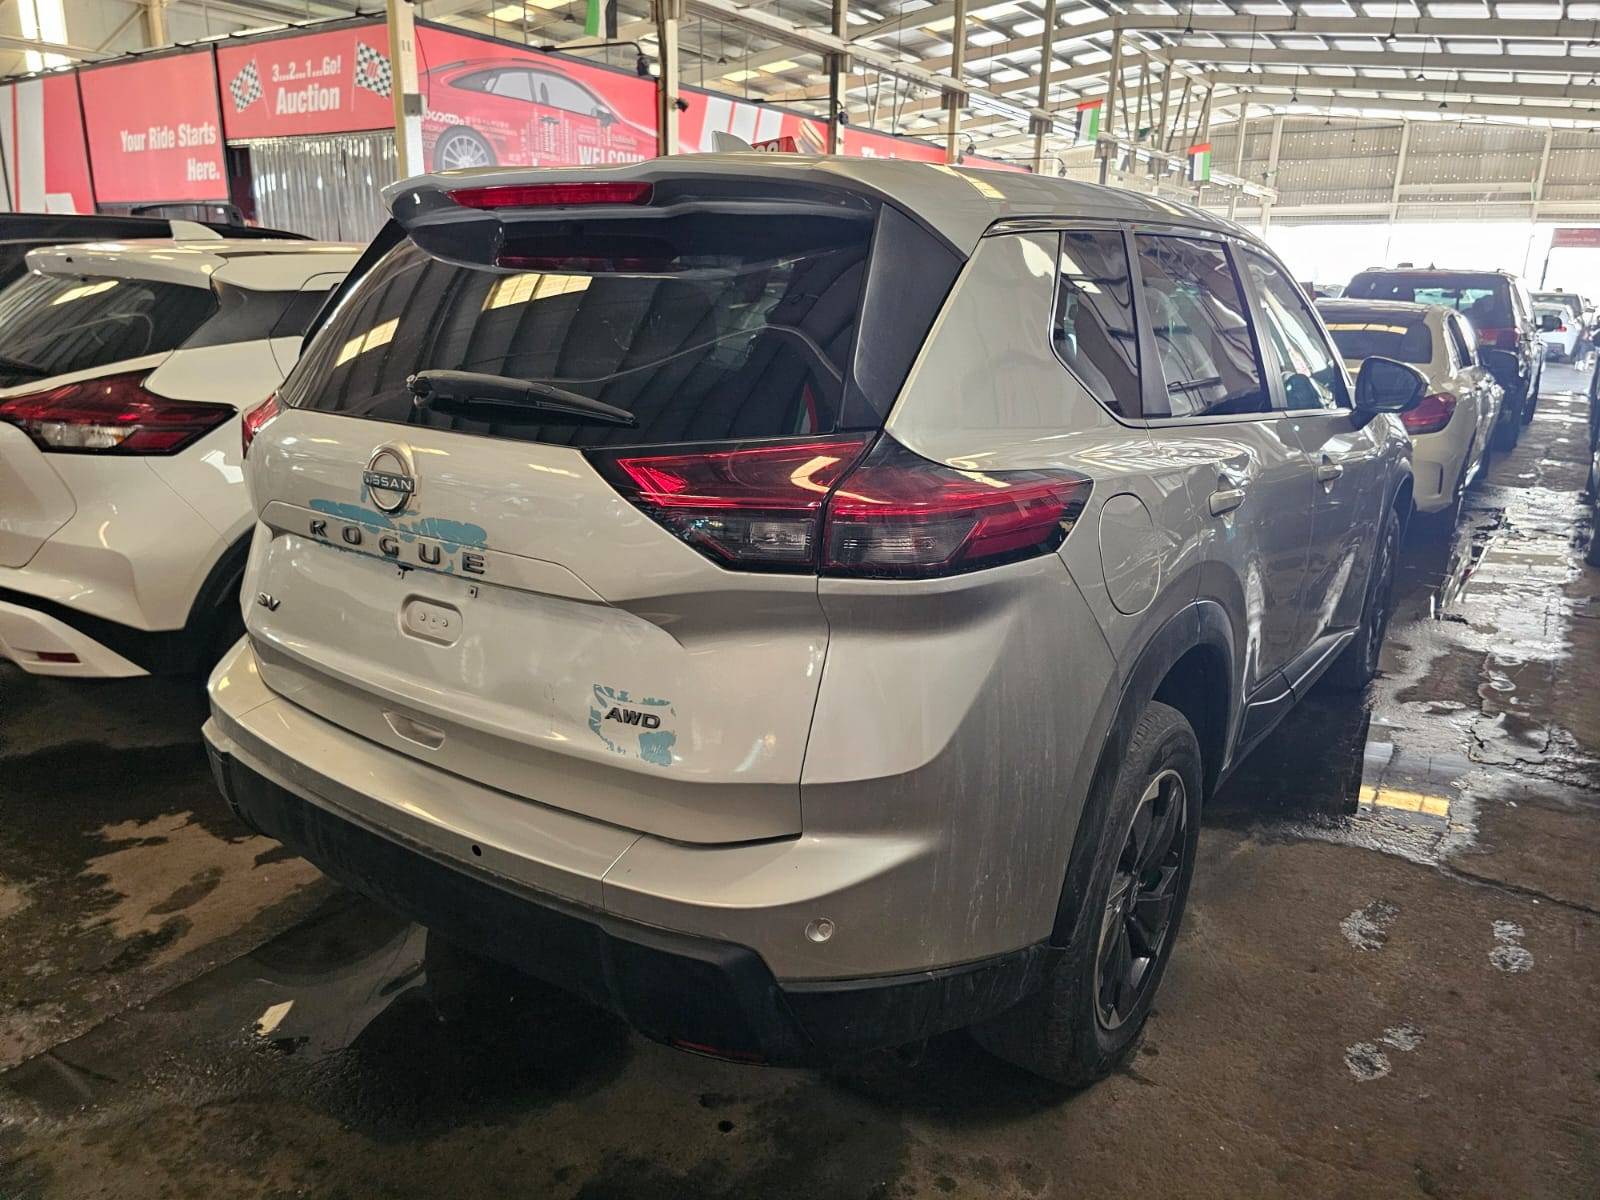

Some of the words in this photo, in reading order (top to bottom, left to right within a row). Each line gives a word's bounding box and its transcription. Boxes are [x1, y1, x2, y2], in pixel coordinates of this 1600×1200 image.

[275, 85, 341, 116] Auction
[120, 130, 145, 153] Your
[148, 126, 175, 150] Ride
[178, 121, 217, 148] Starts
[186, 157, 221, 182] Here.
[364, 474, 412, 491] SSAN
[309, 517, 487, 575] ROGUE
[257, 591, 281, 612] SV
[604, 706, 662, 730] AWD
